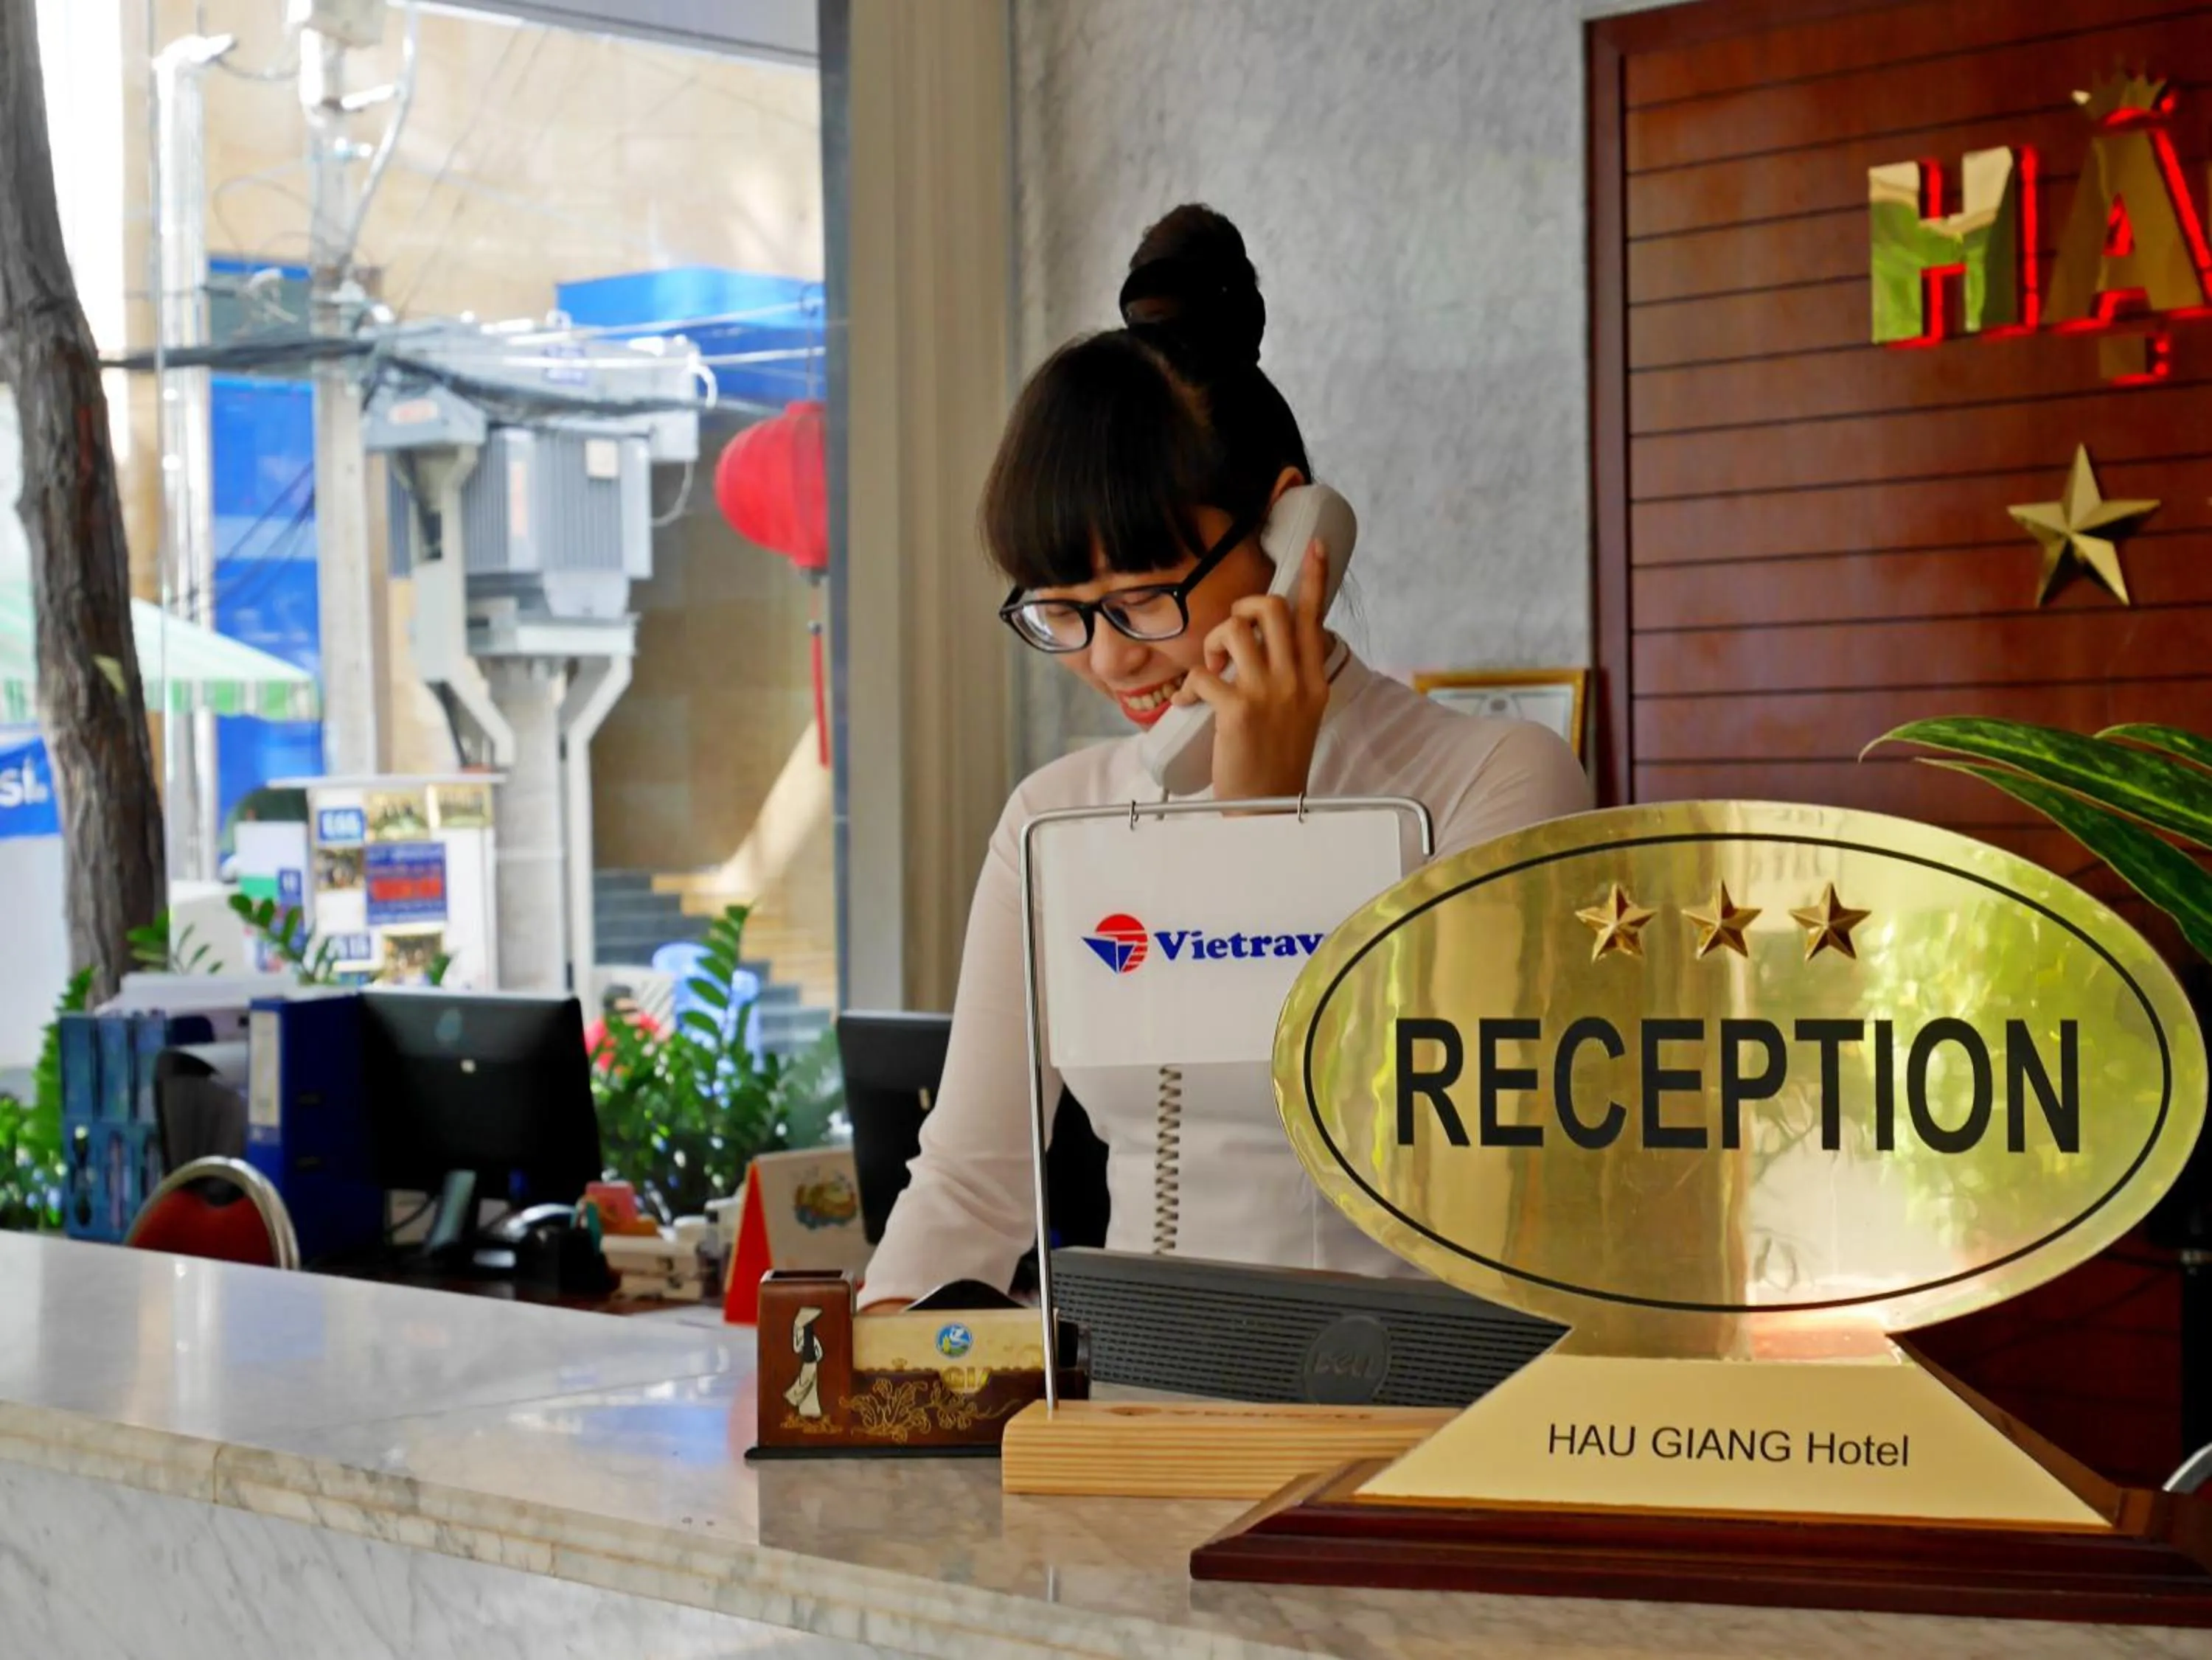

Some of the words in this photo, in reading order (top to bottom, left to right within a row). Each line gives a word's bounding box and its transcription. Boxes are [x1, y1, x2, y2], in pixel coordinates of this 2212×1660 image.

[1395, 1016, 2079, 1154] RECEPTION
[1548, 1423, 1636, 1457] HAU
[1651, 1426, 1792, 1462] GIANG
[1806, 1431, 1910, 1467] Hotel
